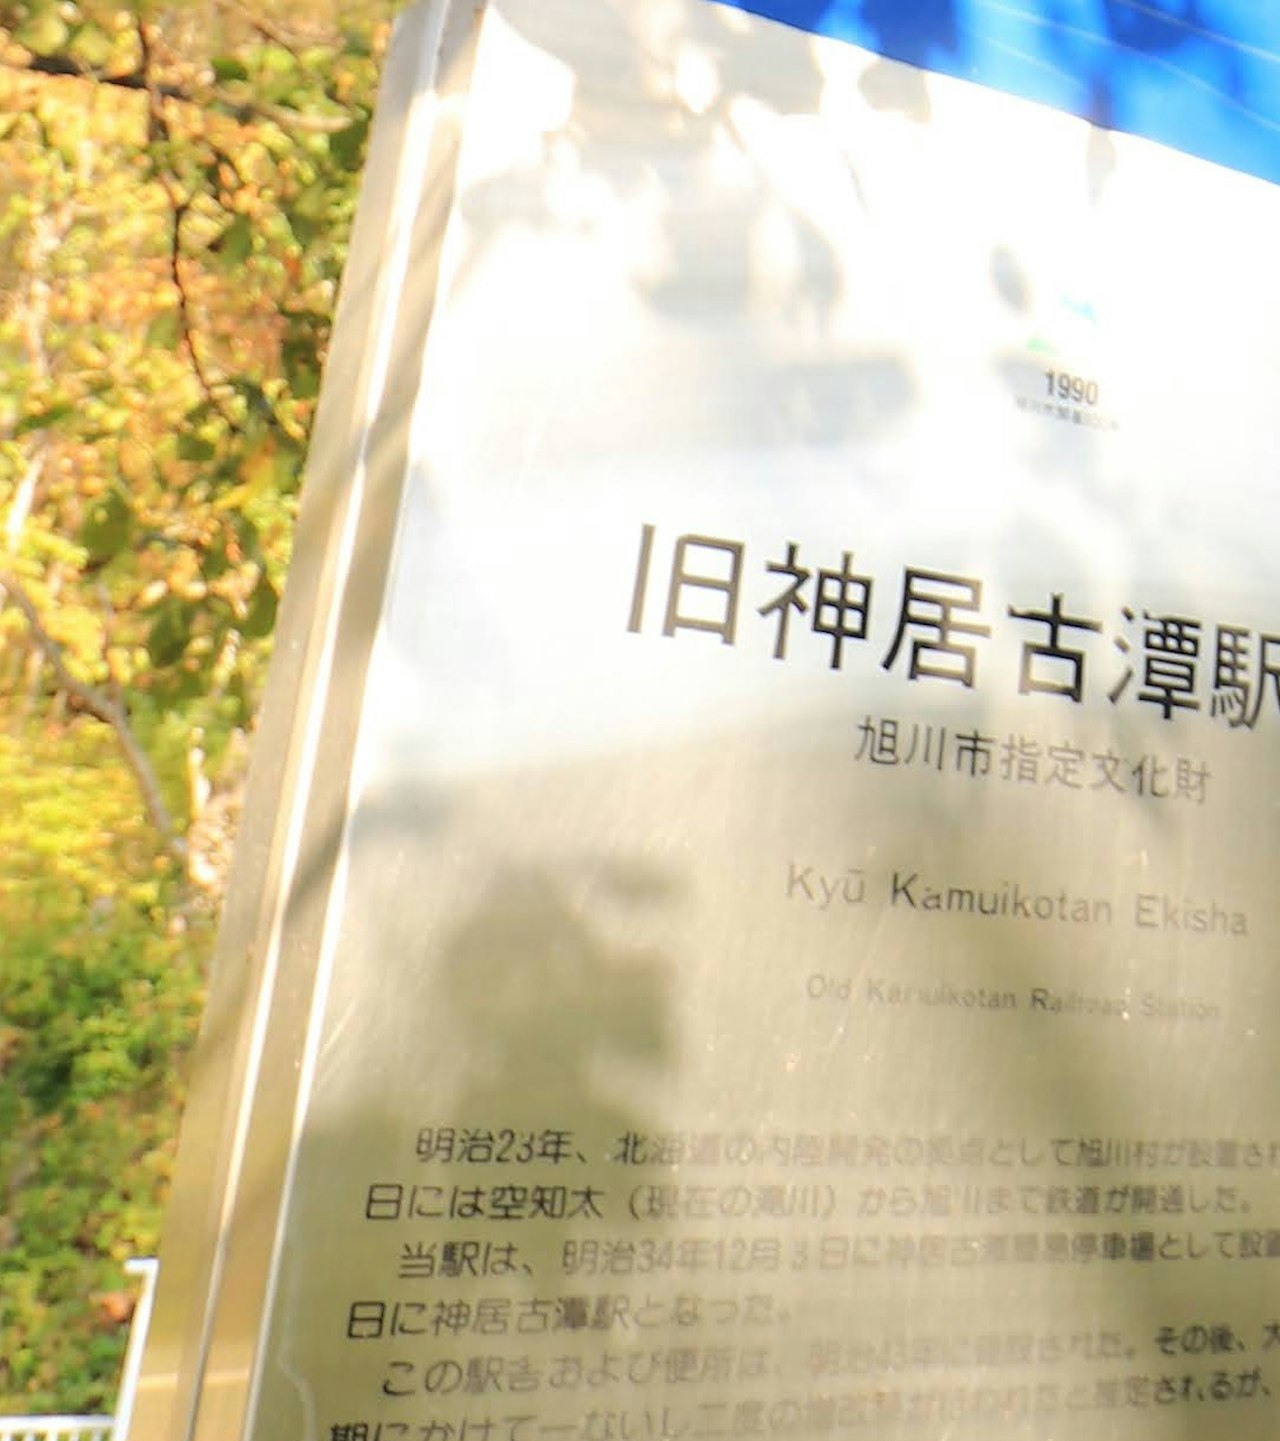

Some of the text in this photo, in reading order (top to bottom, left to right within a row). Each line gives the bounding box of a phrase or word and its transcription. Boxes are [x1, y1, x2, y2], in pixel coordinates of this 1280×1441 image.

[1045, 369, 1098, 405] 1990
[852, 714, 1211, 806] 旭川市指定文化財
[786, 862, 1250, 937] Kyū Kamuikotan Ekisha
[805, 973, 852, 1002] Old
[866, 977, 1017, 1010] Kamuikotan
[345, 1292, 792, 1341] 日に神居古潭駅となった。
